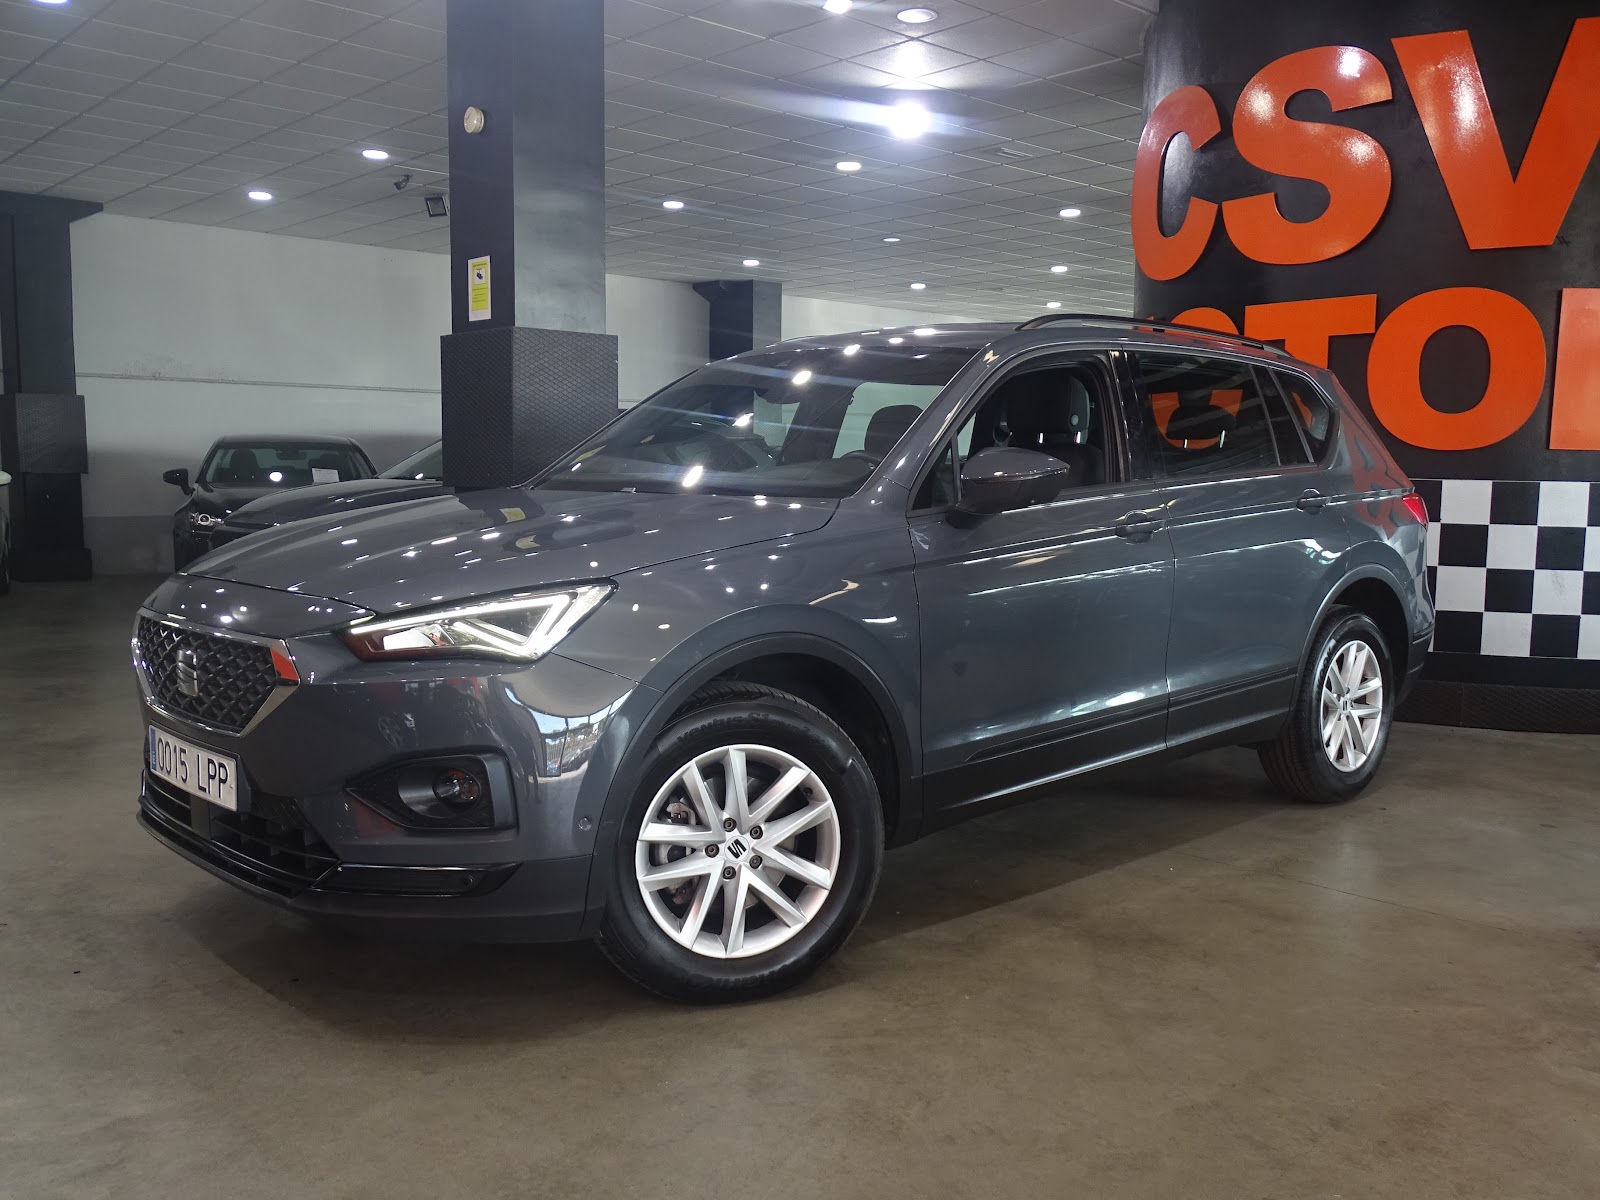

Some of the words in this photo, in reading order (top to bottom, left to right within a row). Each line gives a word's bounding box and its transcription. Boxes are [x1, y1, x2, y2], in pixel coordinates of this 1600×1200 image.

[1131, 17, 1600, 281] CSV
[157, 737, 188, 783] 0015
[197, 753, 228, 799] LPP
